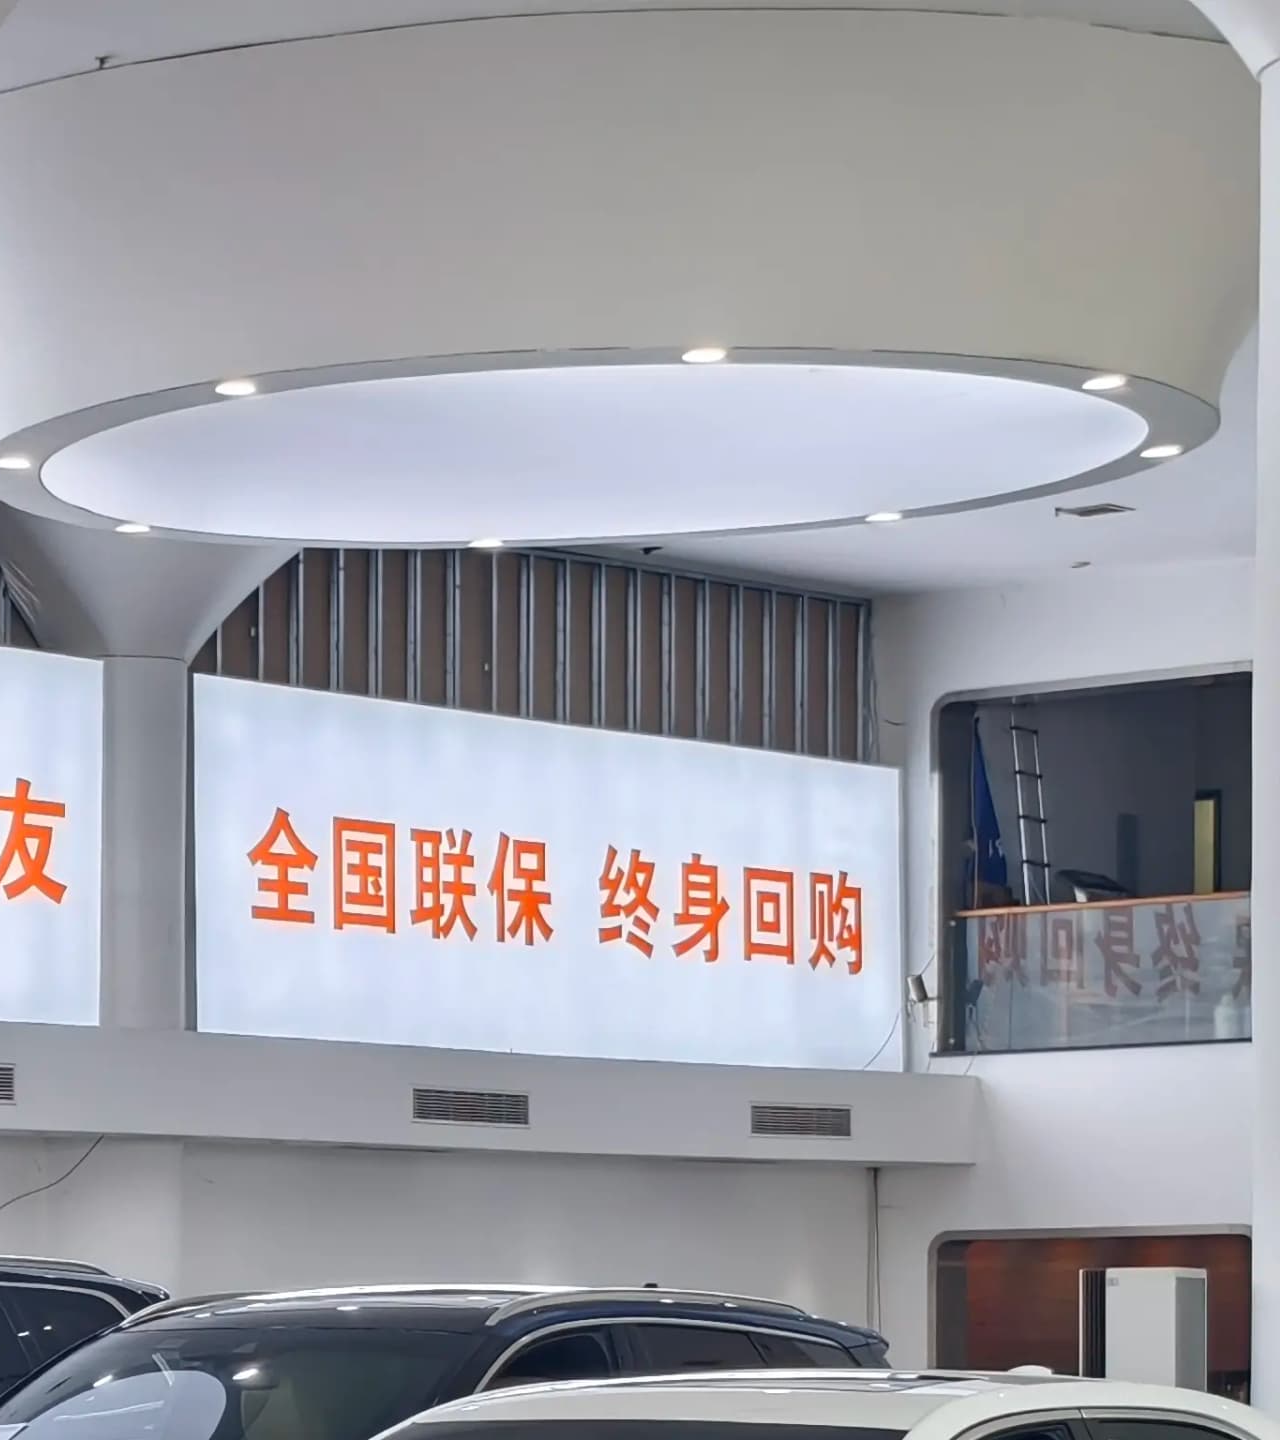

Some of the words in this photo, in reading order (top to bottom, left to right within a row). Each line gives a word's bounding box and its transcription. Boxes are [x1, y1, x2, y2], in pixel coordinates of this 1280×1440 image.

[248, 808, 553, 944] 全国联保
[598, 847, 864, 974] 终身回购
